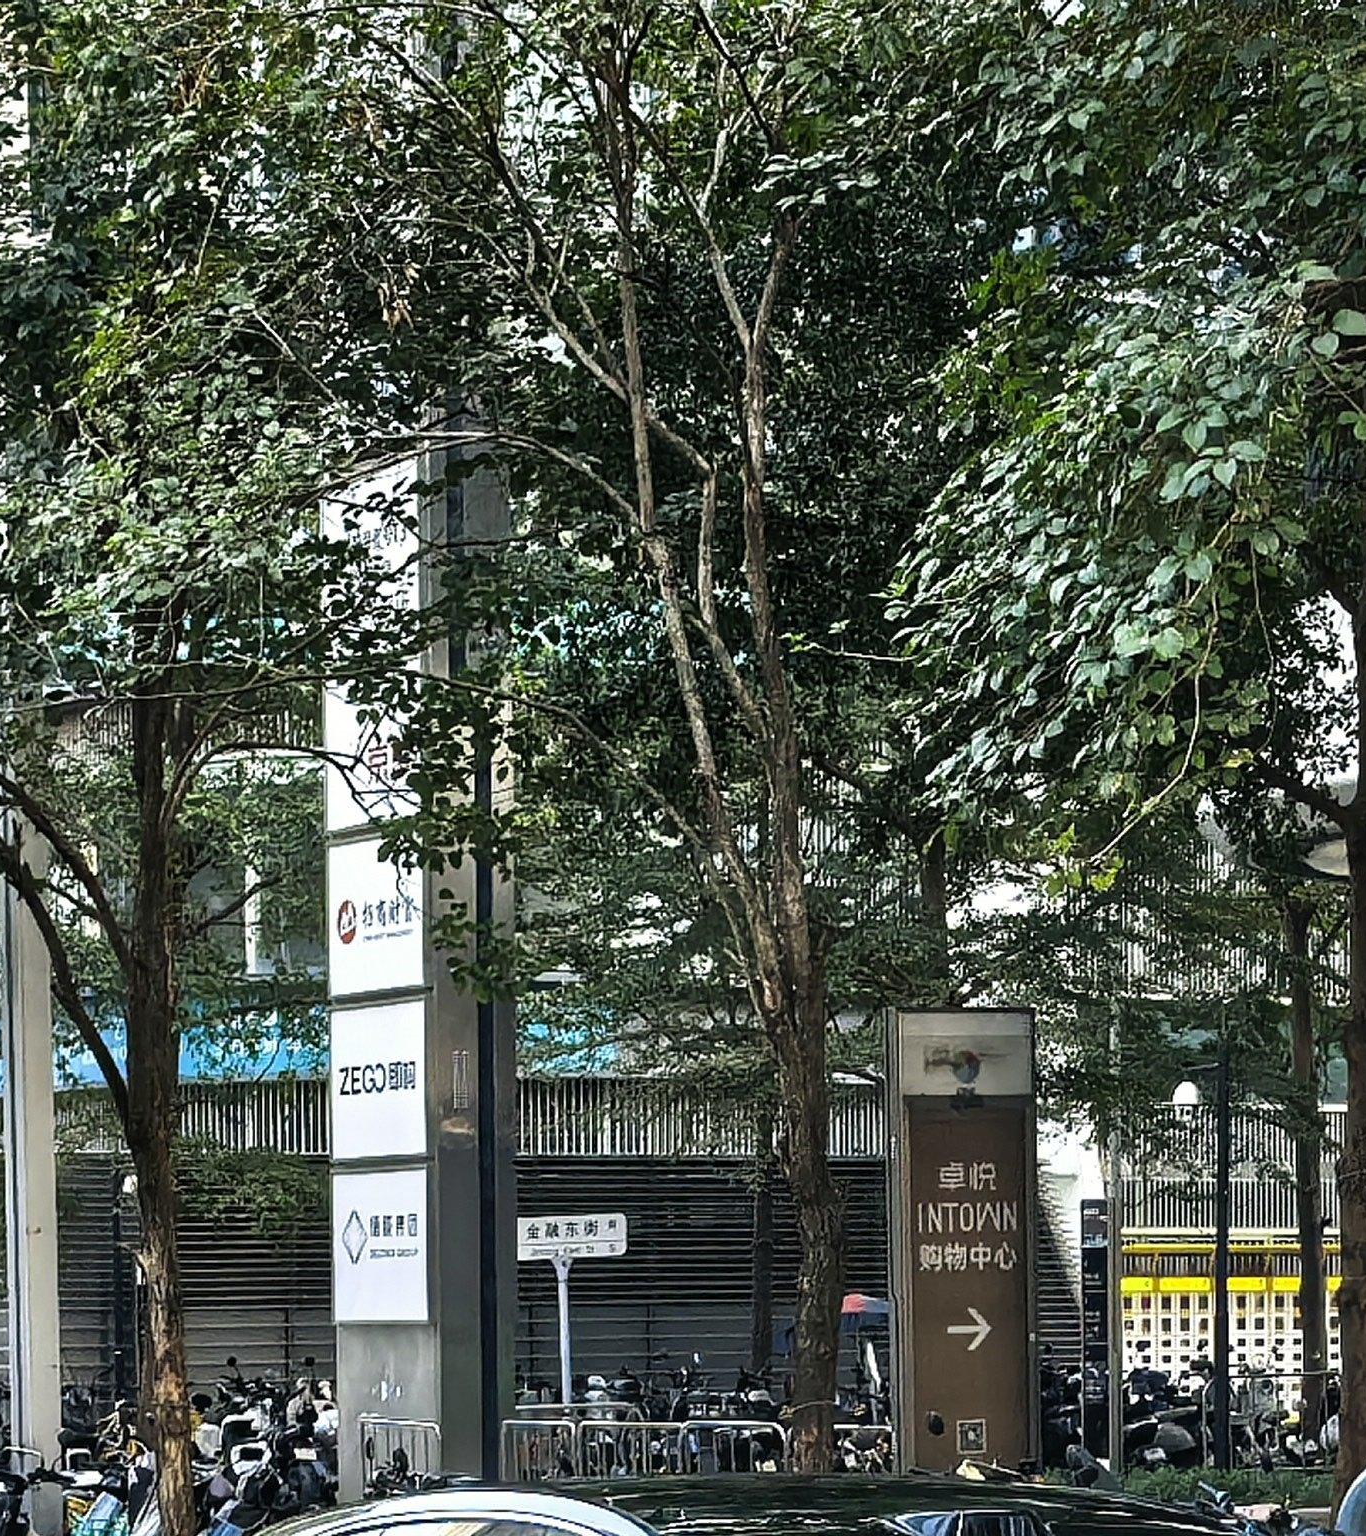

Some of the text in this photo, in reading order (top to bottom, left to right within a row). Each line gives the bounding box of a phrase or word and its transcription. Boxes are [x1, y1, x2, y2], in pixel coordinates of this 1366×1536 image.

[339, 1063, 386, 1095] ZEGO
[937, 1162, 997, 1192] 卓悦
[526, 1220, 599, 1240] 金融东街
[917, 1201, 1018, 1234] INTOWN
[918, 1242, 1018, 1272] 购物中心
